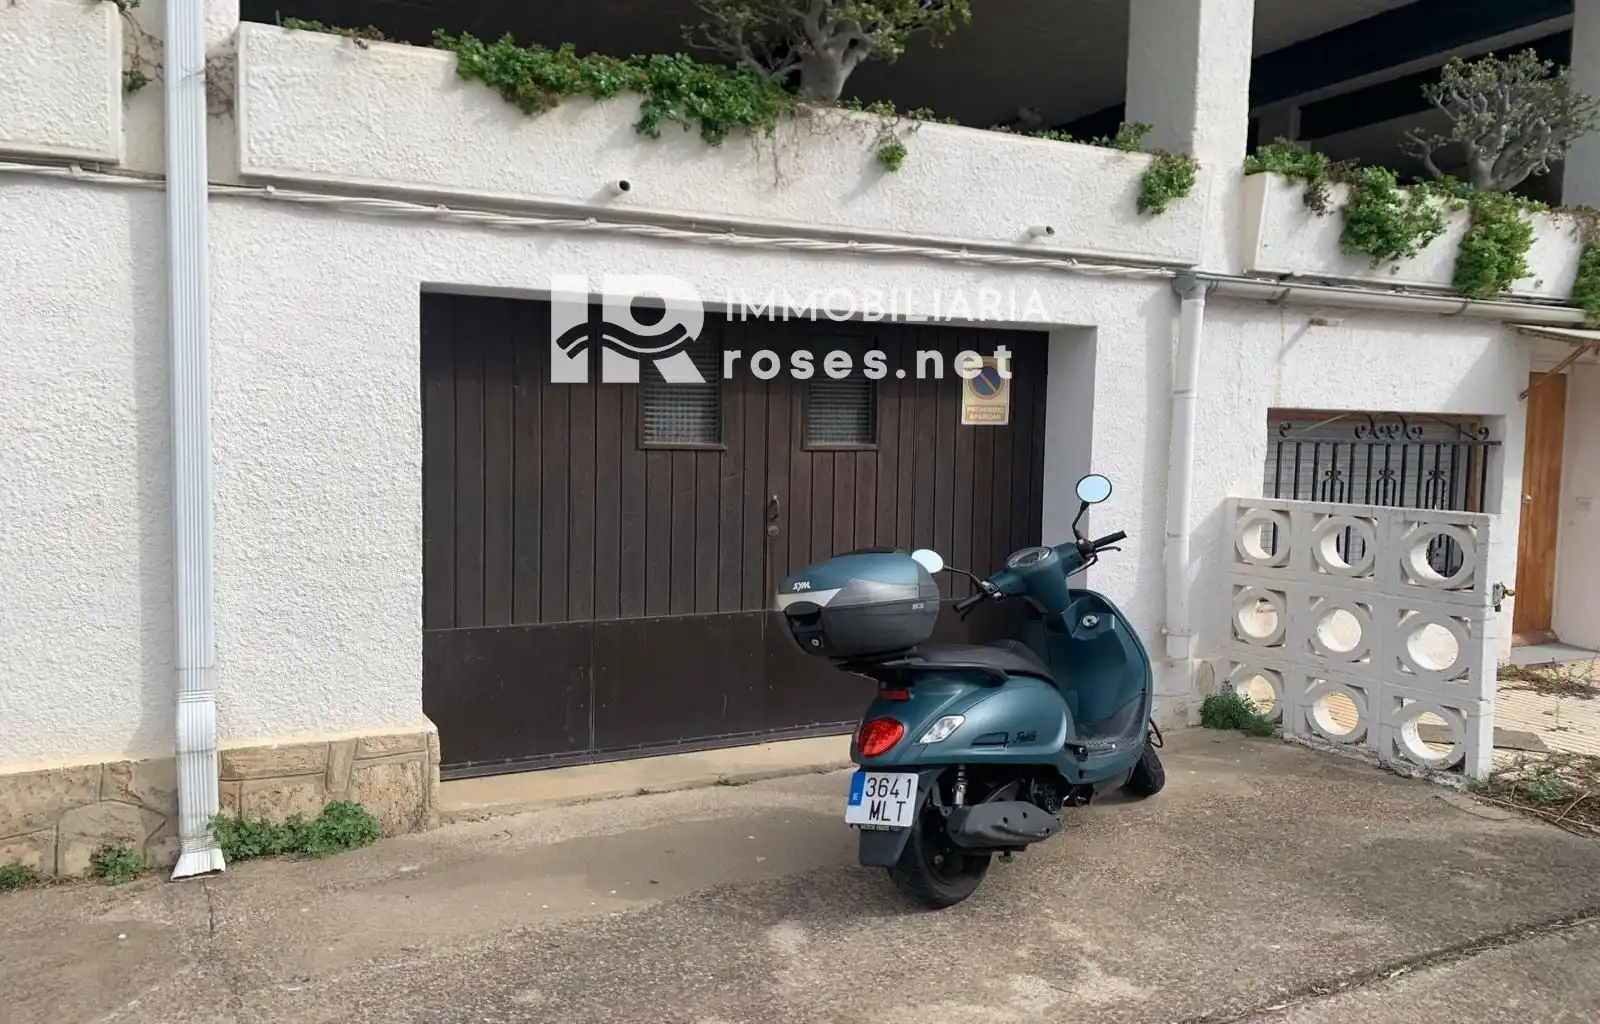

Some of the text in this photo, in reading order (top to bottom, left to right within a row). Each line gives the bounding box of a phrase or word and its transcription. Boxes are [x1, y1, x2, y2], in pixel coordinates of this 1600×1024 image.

[792, 580, 812, 591] SYM
[865, 777, 912, 799] 3641
[868, 800, 907, 822] MLT
